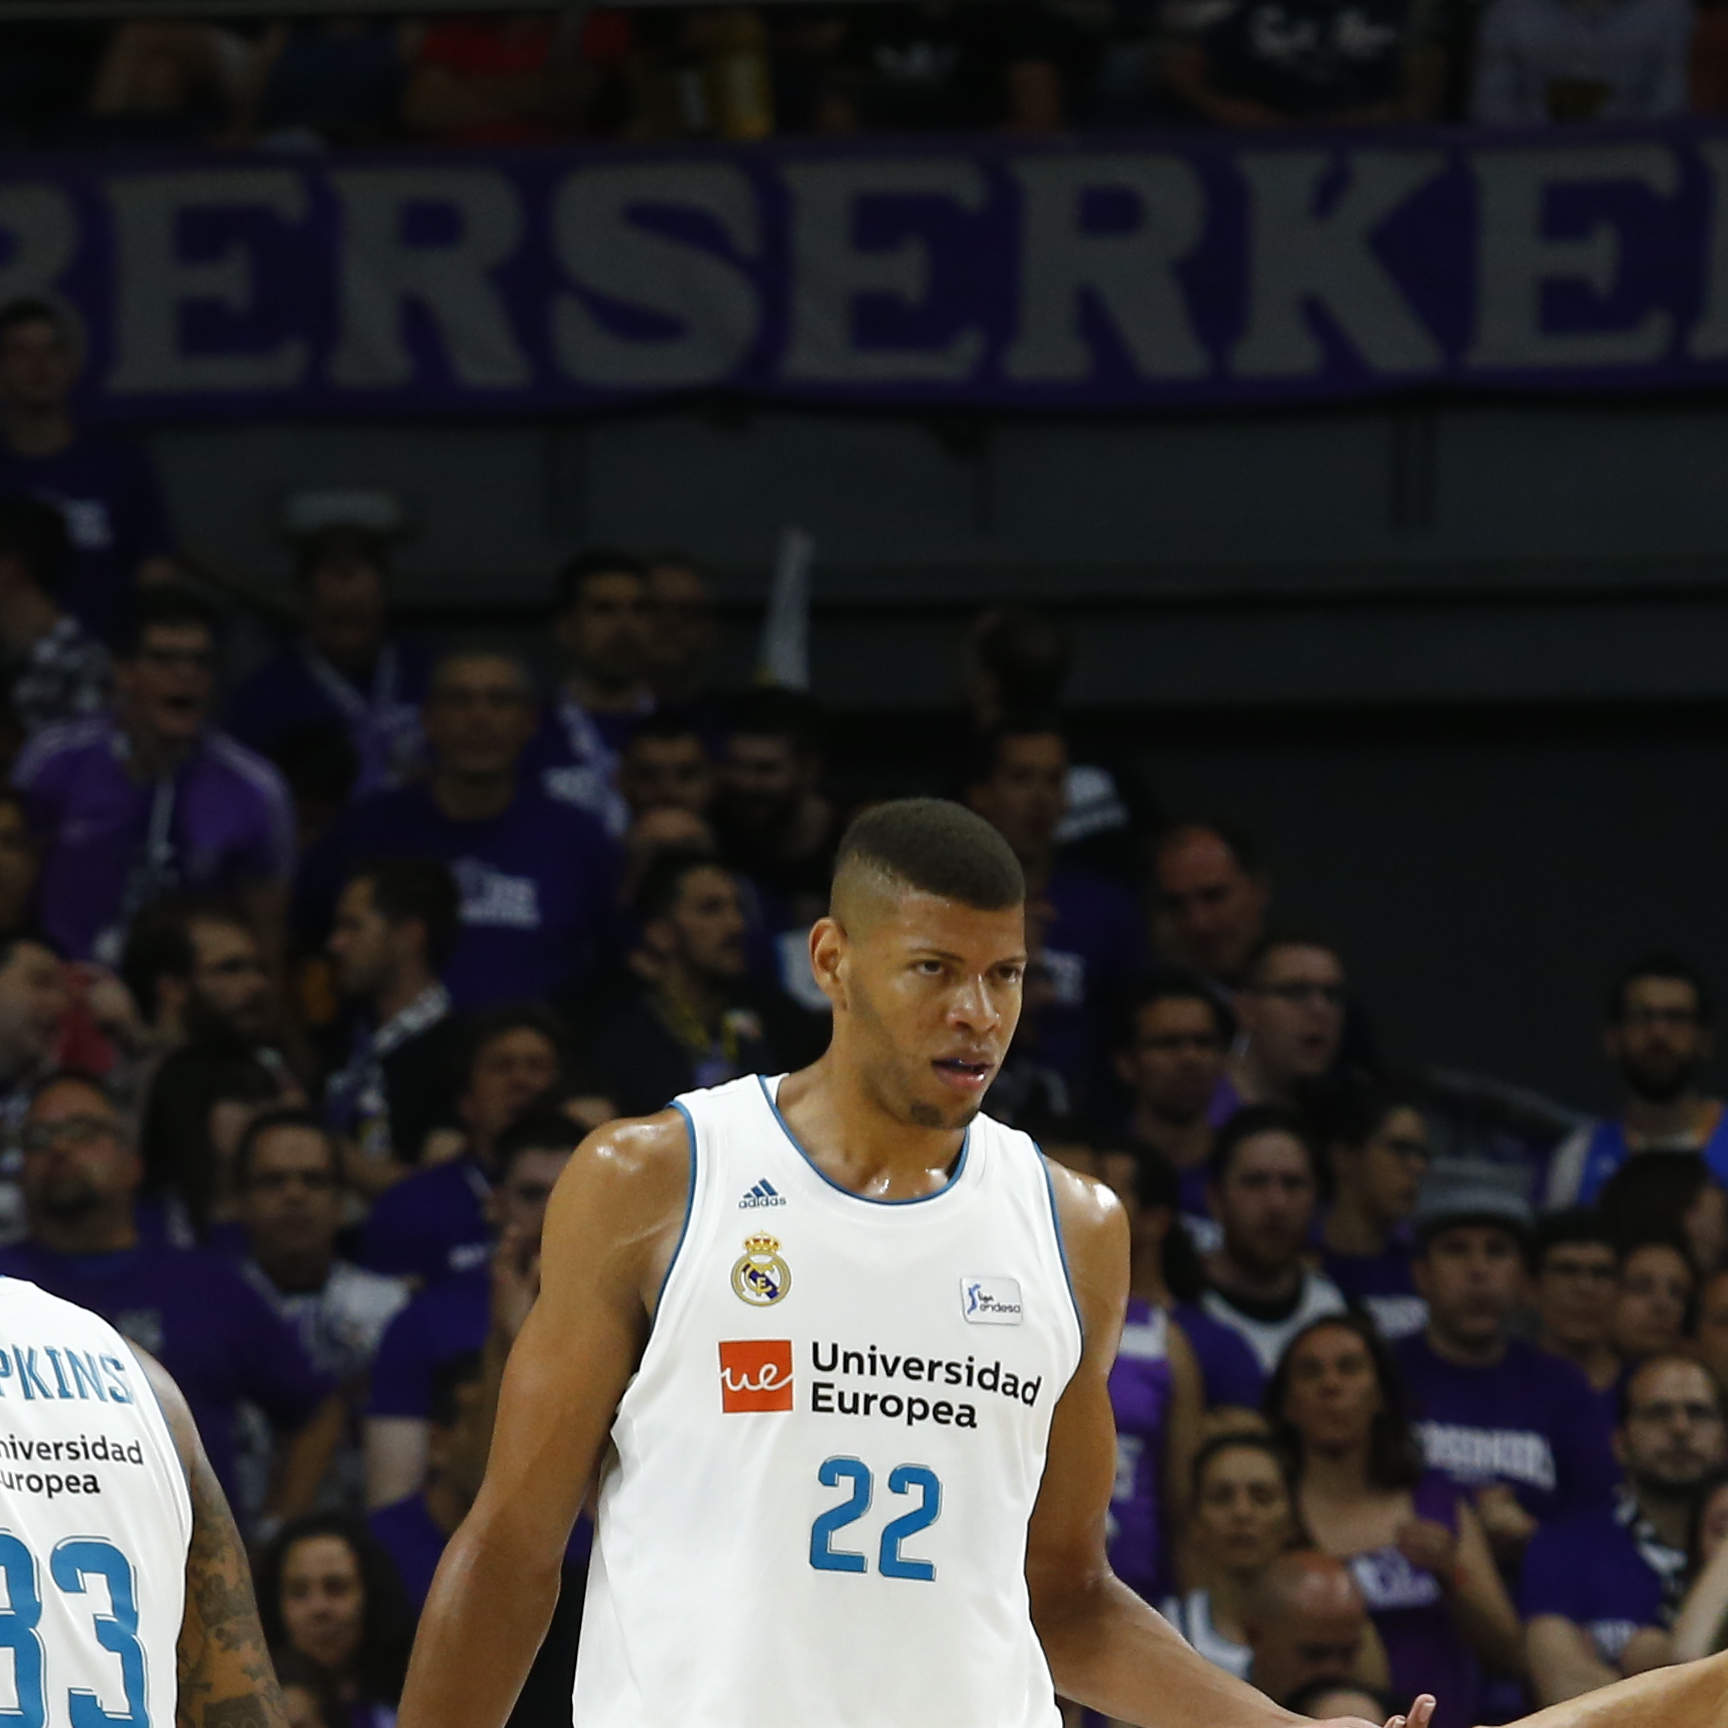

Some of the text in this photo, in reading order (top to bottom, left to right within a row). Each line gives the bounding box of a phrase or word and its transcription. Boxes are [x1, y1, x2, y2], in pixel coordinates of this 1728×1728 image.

[738, 1196, 787, 1210] adidas
[811, 1341, 1042, 1408] Universidad
[811, 1382, 978, 1428] Europea
[809, 1454, 944, 1583] 22
